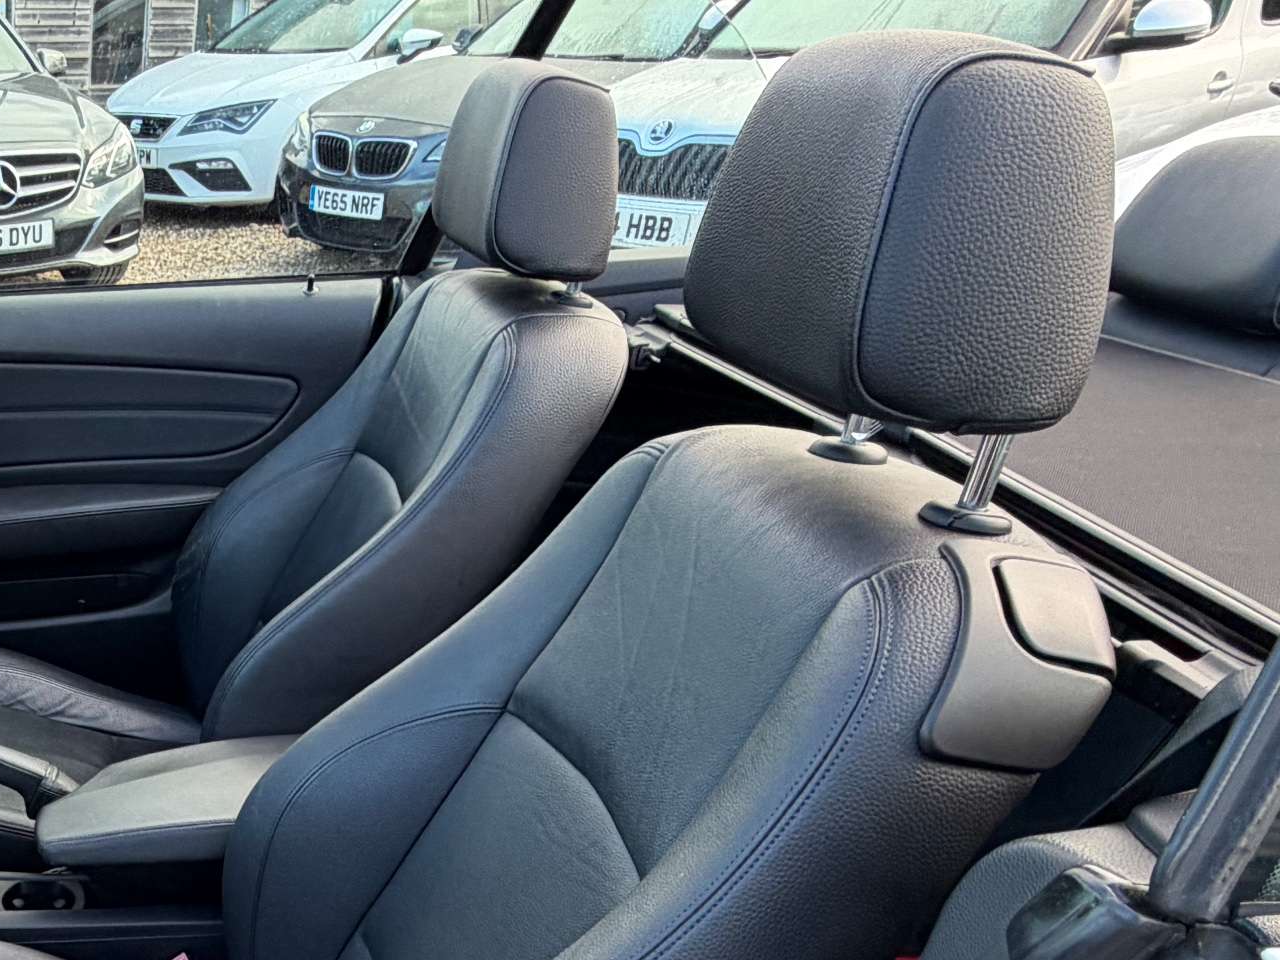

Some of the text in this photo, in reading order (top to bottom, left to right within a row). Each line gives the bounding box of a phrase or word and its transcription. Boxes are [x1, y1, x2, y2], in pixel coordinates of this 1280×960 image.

[317, 189, 381, 215] YE65 NRF
[9, 223, 43, 247] DYU
[625, 213, 673, 242] HBB
